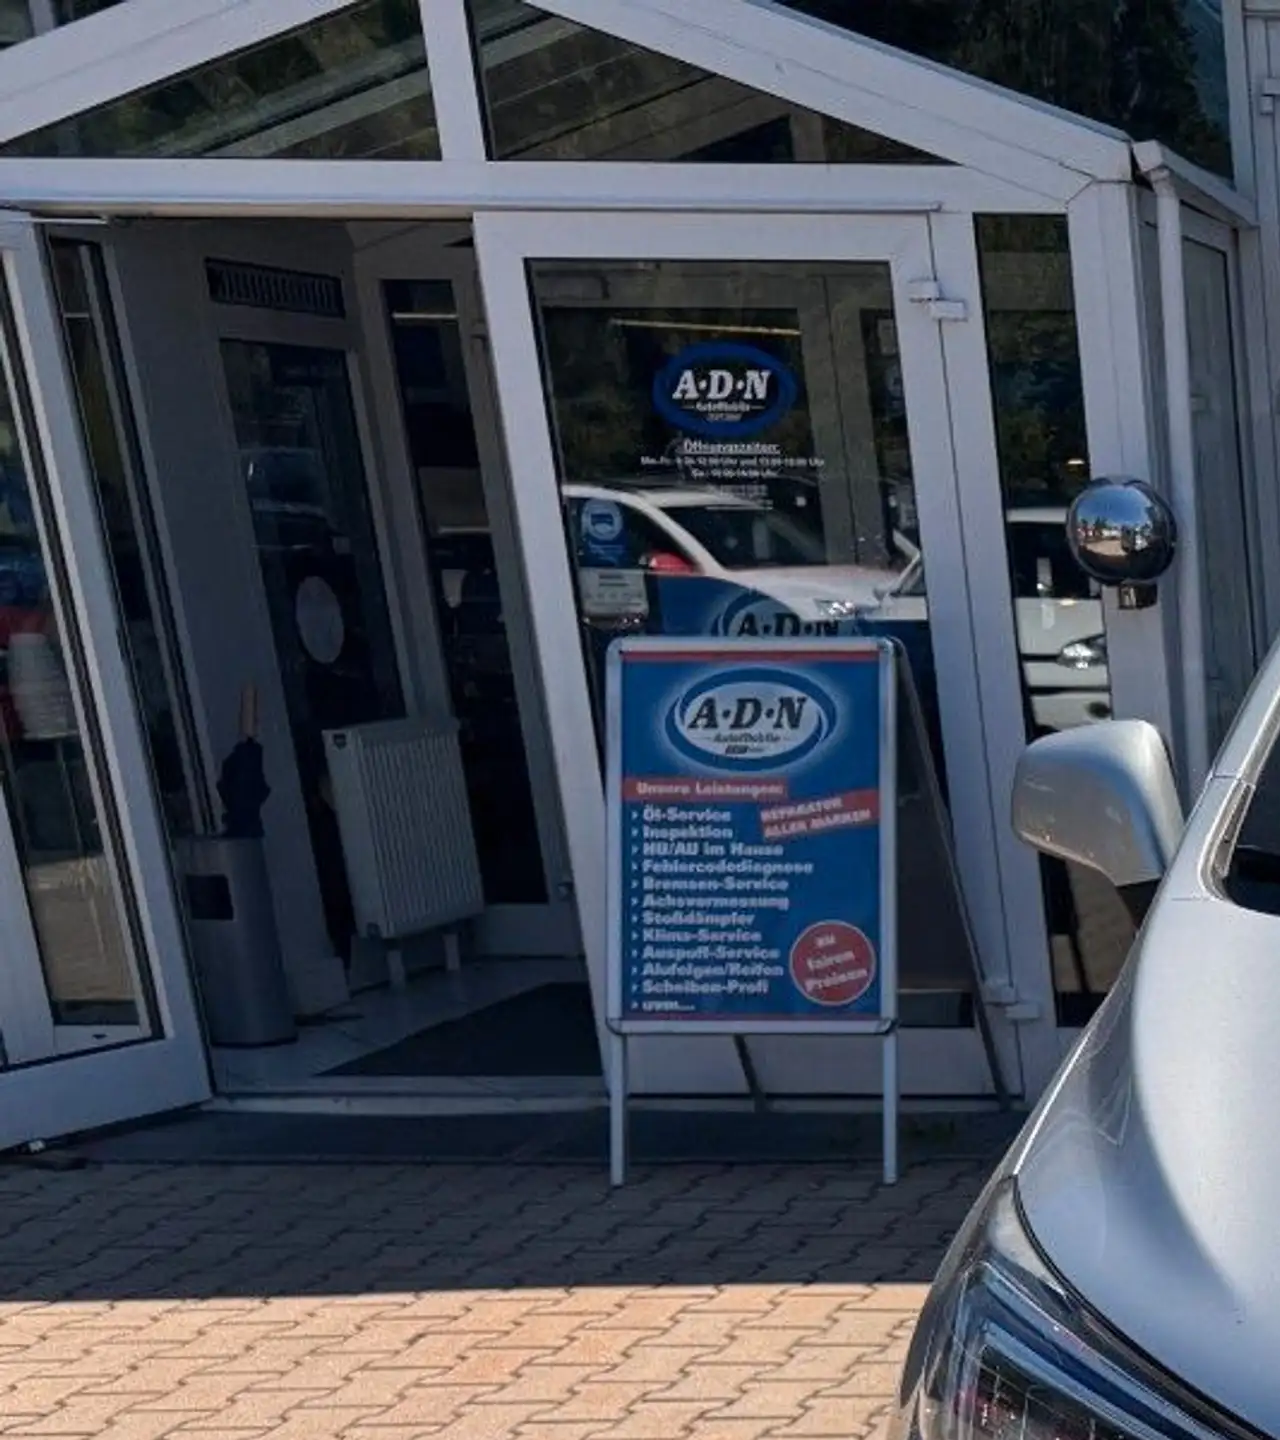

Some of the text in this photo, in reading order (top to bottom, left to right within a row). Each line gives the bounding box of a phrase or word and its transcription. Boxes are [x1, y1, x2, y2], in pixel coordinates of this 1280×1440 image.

[636, 782, 690, 795] Unsere
[642, 804, 731, 822] Öl-Service
[642, 824, 733, 841] Inspektion
[642, 842, 784, 856] HU/AU im Hause
[642, 859, 813, 879] Fehlercodediagnose
[642, 876, 789, 891] Bremsen-Service
[642, 894, 790, 911] Achsvermessung
[642, 910, 755, 927] Stoßdämpfer
[642, 928, 762, 942] Klima-Service
[642, 945, 780, 961] Auspuff-Service
[642, 962, 784, 980] Alufelgen/Reifen
[642, 979, 769, 994] Scheiben-Profi
